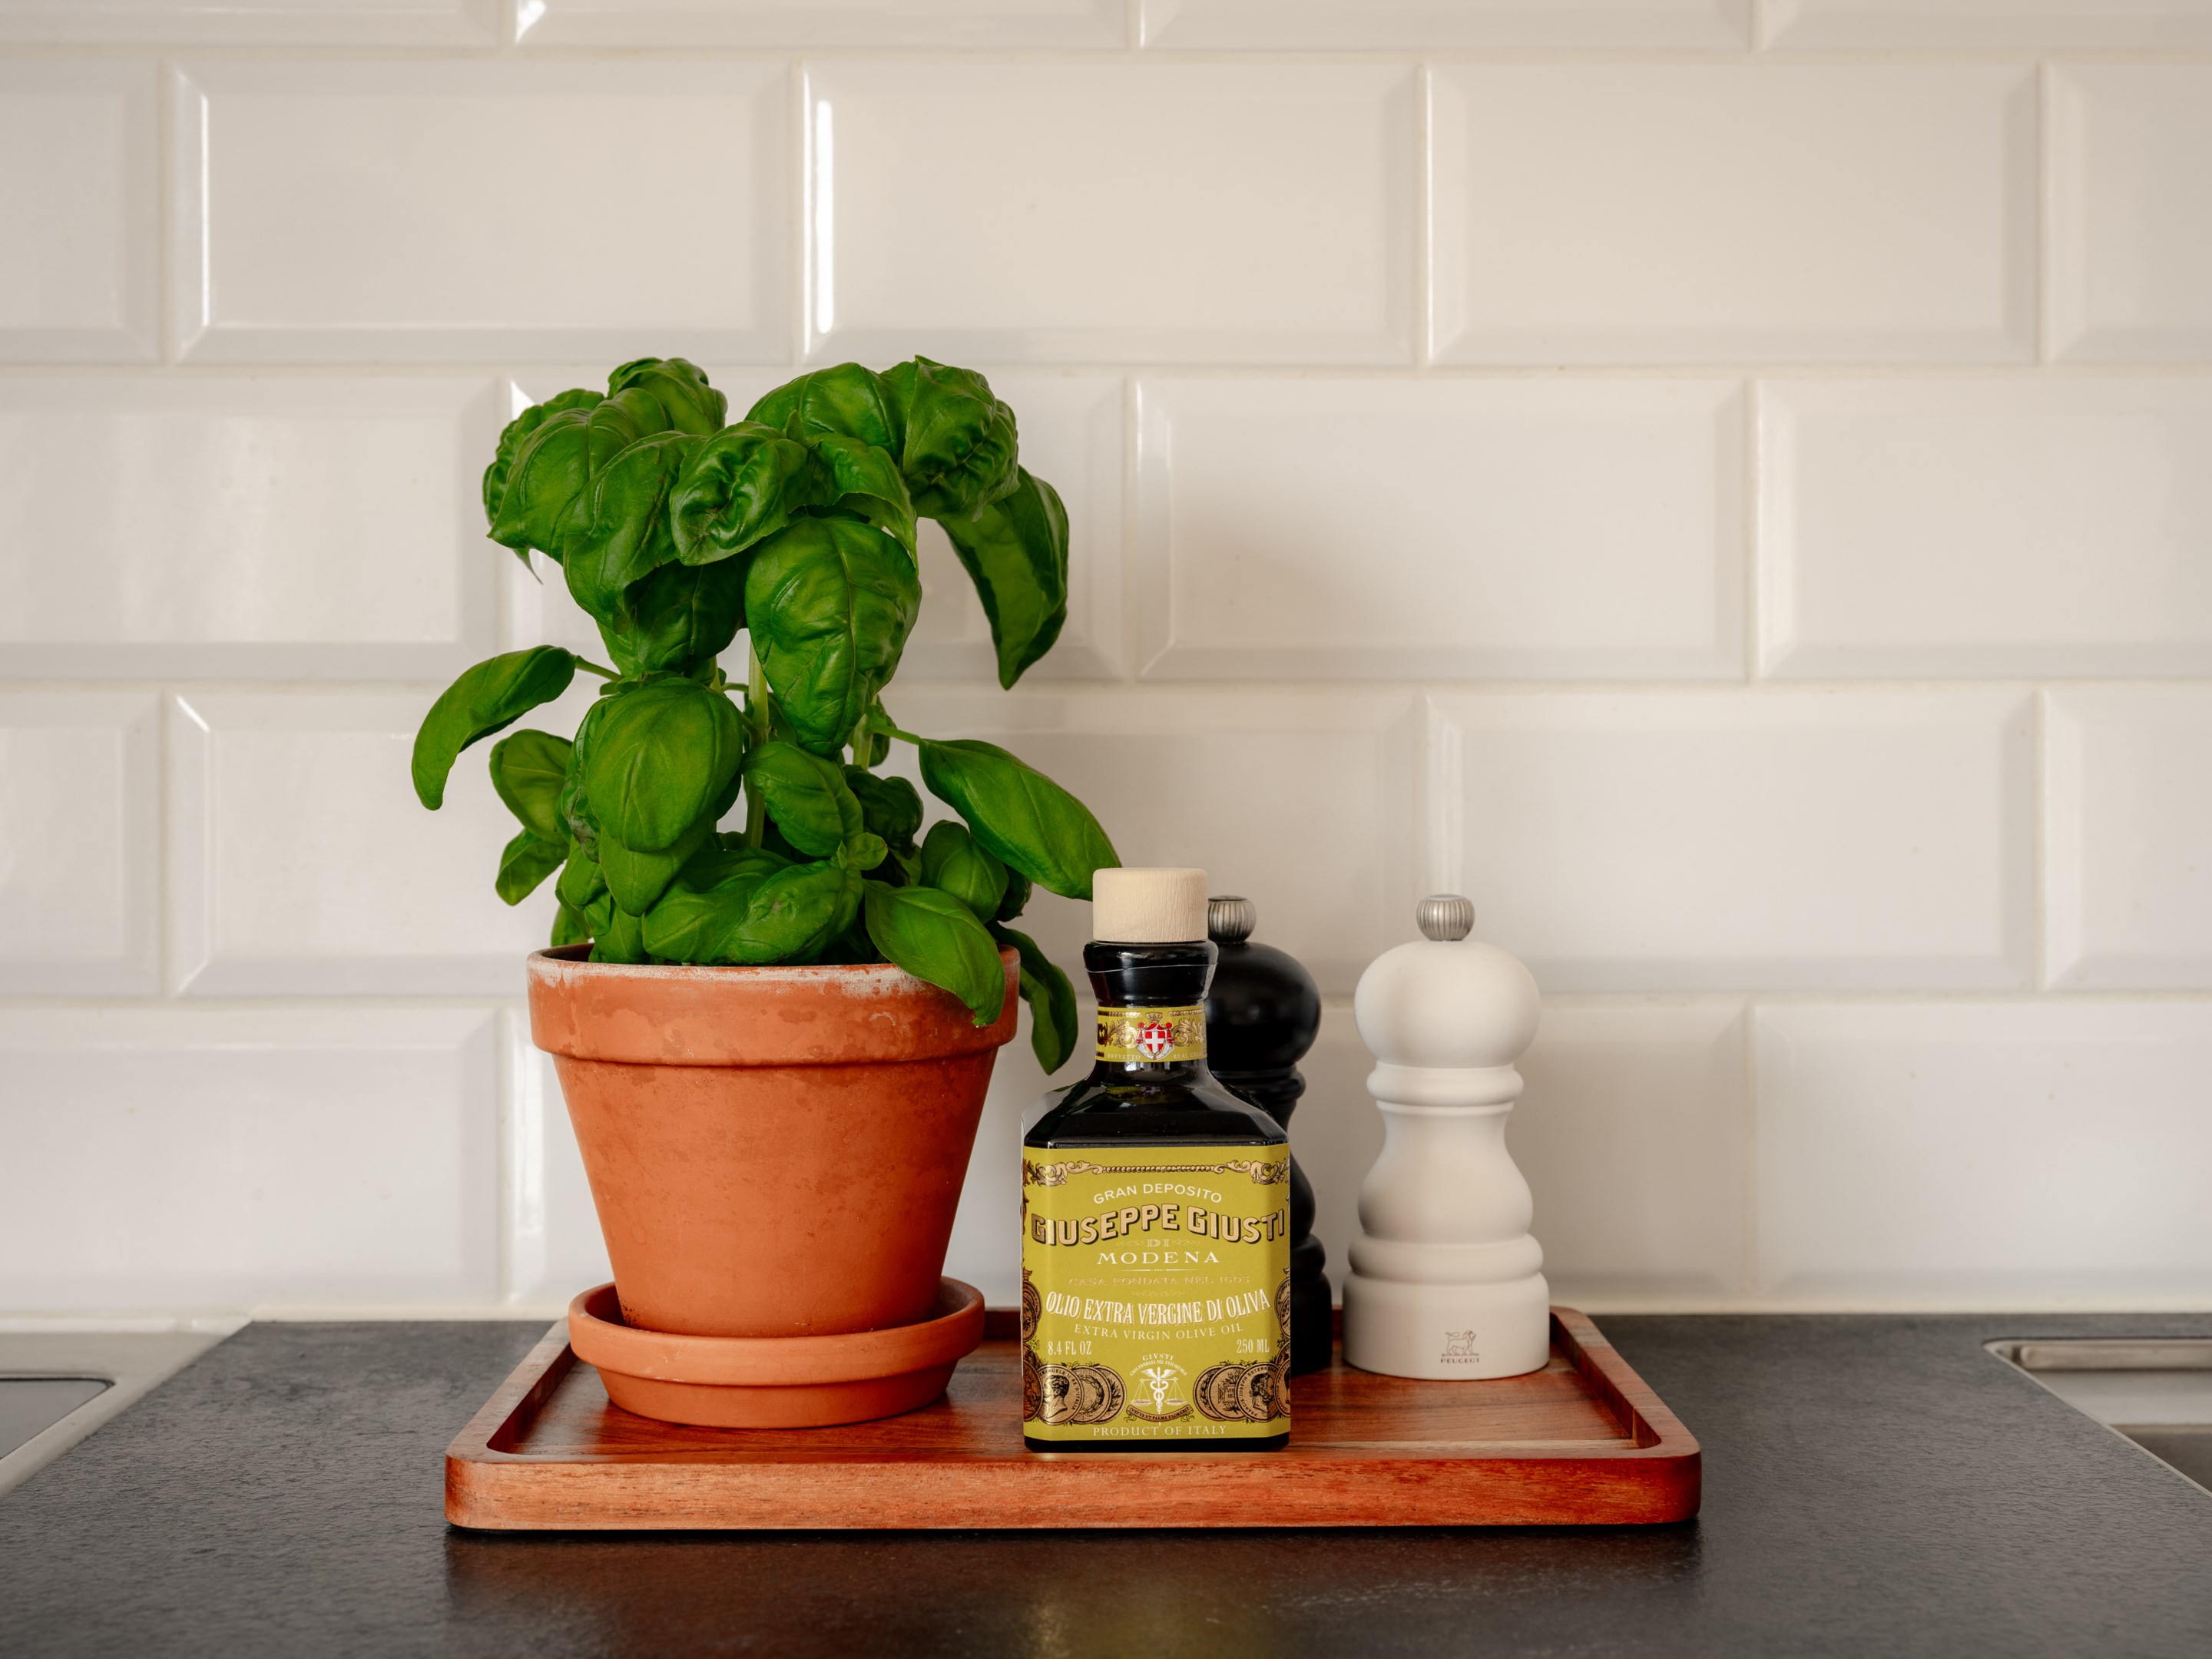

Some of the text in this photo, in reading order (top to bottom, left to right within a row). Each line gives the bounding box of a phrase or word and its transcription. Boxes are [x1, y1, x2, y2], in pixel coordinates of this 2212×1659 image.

[1094, 1184, 1222, 1204] GRAN DEPOSITO
[1031, 1204, 1284, 1246] GIUSEPPE GIUSTI
[1147, 1239, 1170, 1247] DI
[1097, 1251, 1220, 1264] MODENA
[1113, 1277, 1180, 1286] FONDATA
[1184, 1277, 1214, 1285] NEL
[1046, 1291, 1081, 1319] OLIO
[1083, 1299, 1134, 1325] EXTRA
[1138, 1301, 1204, 1326] VERGINE
[1206, 1299, 1224, 1322] DI
[1226, 1289, 1272, 1319] OLIVA
[1075, 1323, 1244, 1339] EXTRA VIRGIN OLIVE OIL
[1048, 1341, 1091, 1355] 8.4 FL OZ
[1237, 1339, 1270, 1353] 250 ML
[1093, 1426, 1227, 1436] PRODUCT OF ITALY
